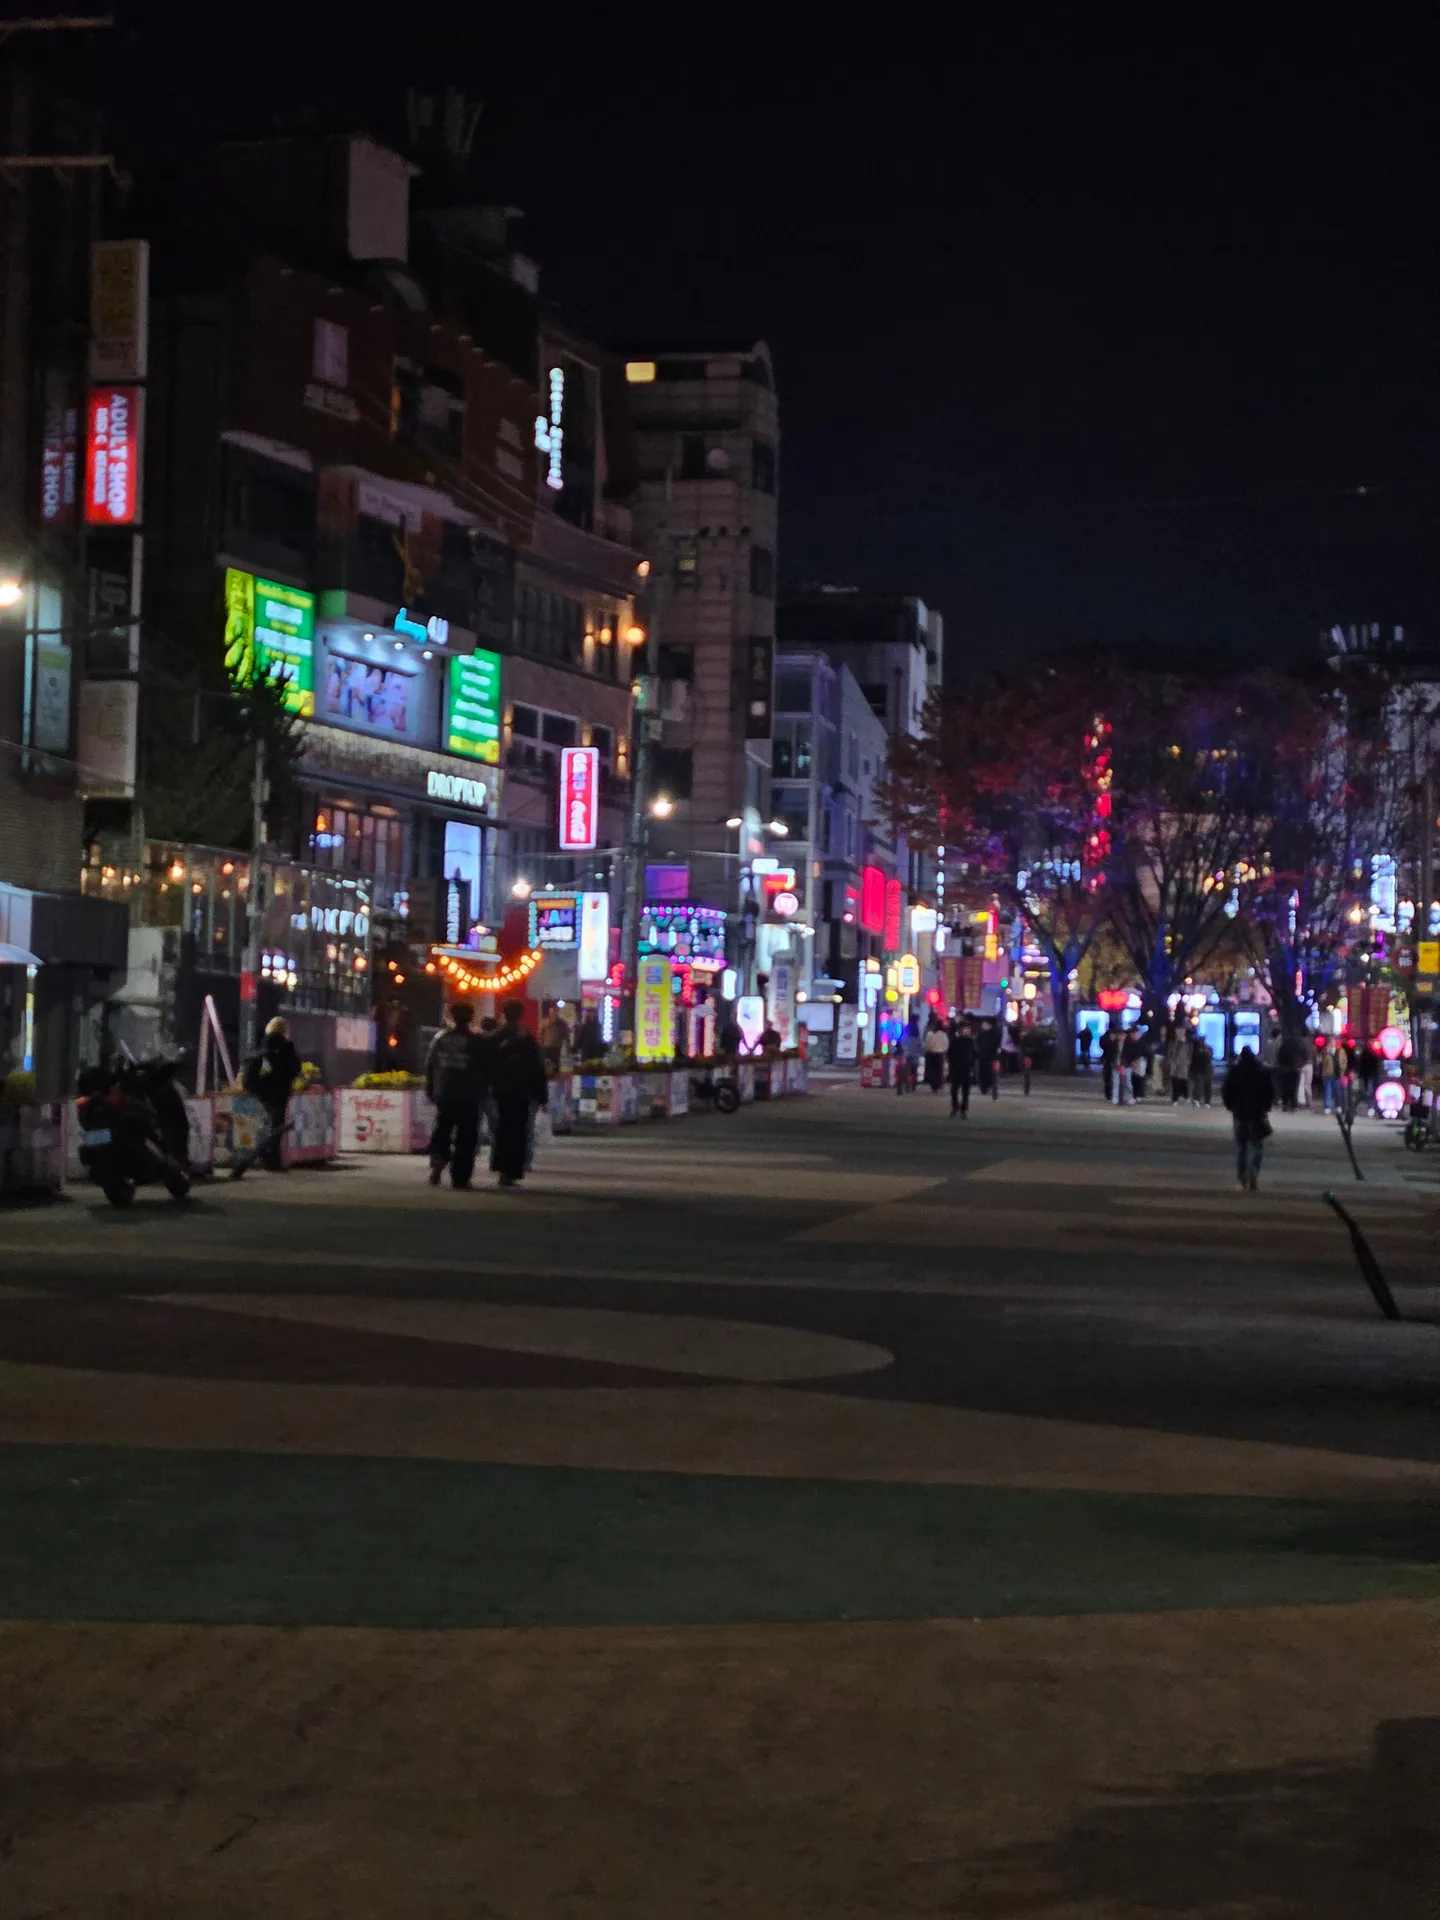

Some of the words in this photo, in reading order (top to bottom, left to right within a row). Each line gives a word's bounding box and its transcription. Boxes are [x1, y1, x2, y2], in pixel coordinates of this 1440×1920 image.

[110, 394, 128, 458] ADULT
[107, 462, 127, 518] SHOP
[538, 910, 574, 925] JAM
[644, 988, 661, 1047] 노래방
